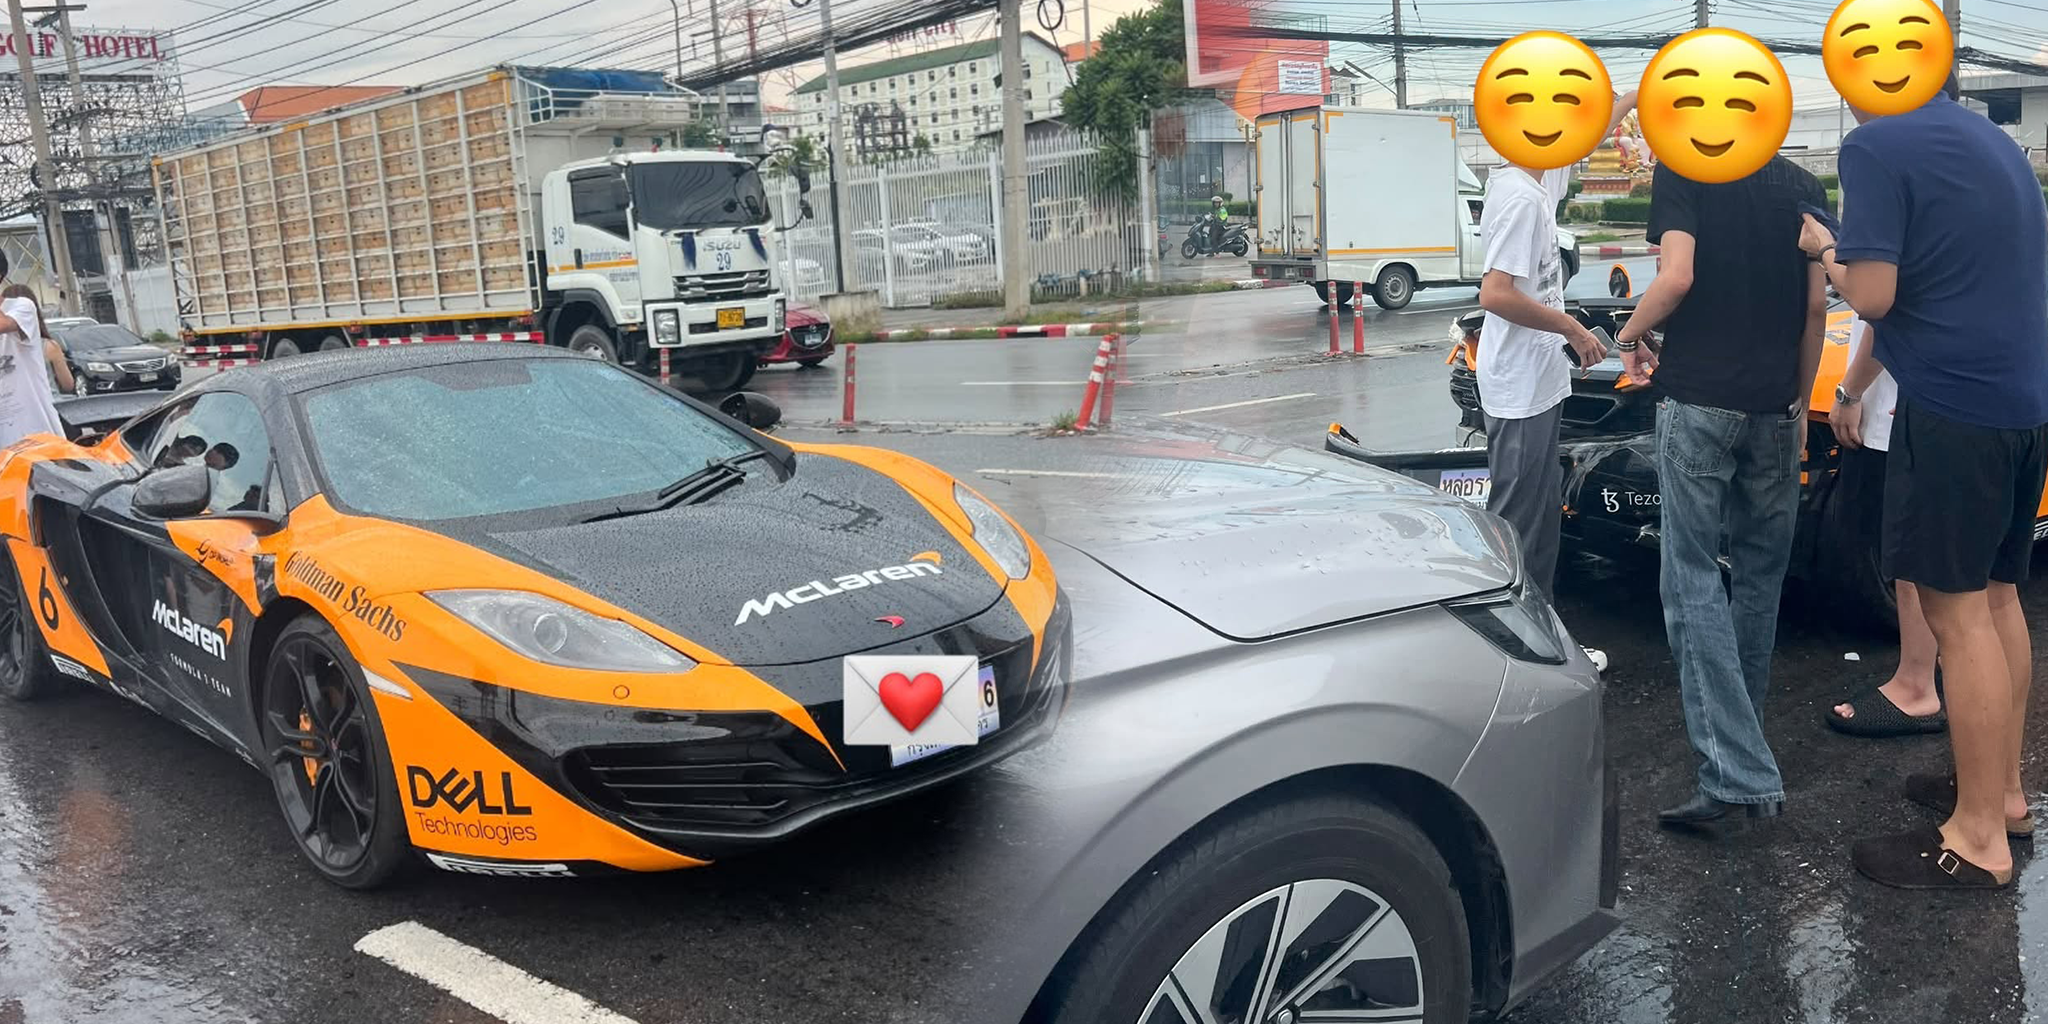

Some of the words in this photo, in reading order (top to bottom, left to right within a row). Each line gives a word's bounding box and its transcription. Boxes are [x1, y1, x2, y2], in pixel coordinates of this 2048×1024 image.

[82, 35, 166, 61] HOTEL
[551, 226, 565, 245] 29
[703, 239, 741, 252] ISUZU
[716, 252, 732, 271] 29
[1625, 491, 1662, 506] Tezo
[39, 566, 59, 631] 6
[284, 550, 345, 603] Goldman
[343, 585, 407, 642] Sachs
[734, 561, 943, 627] McLaren
[152, 599, 227, 661] McLaren
[211, 677, 232, 698] TEAM
[983, 680, 995, 708] 6
[406, 765, 532, 815] DELL
[415, 811, 537, 846] Technologies
